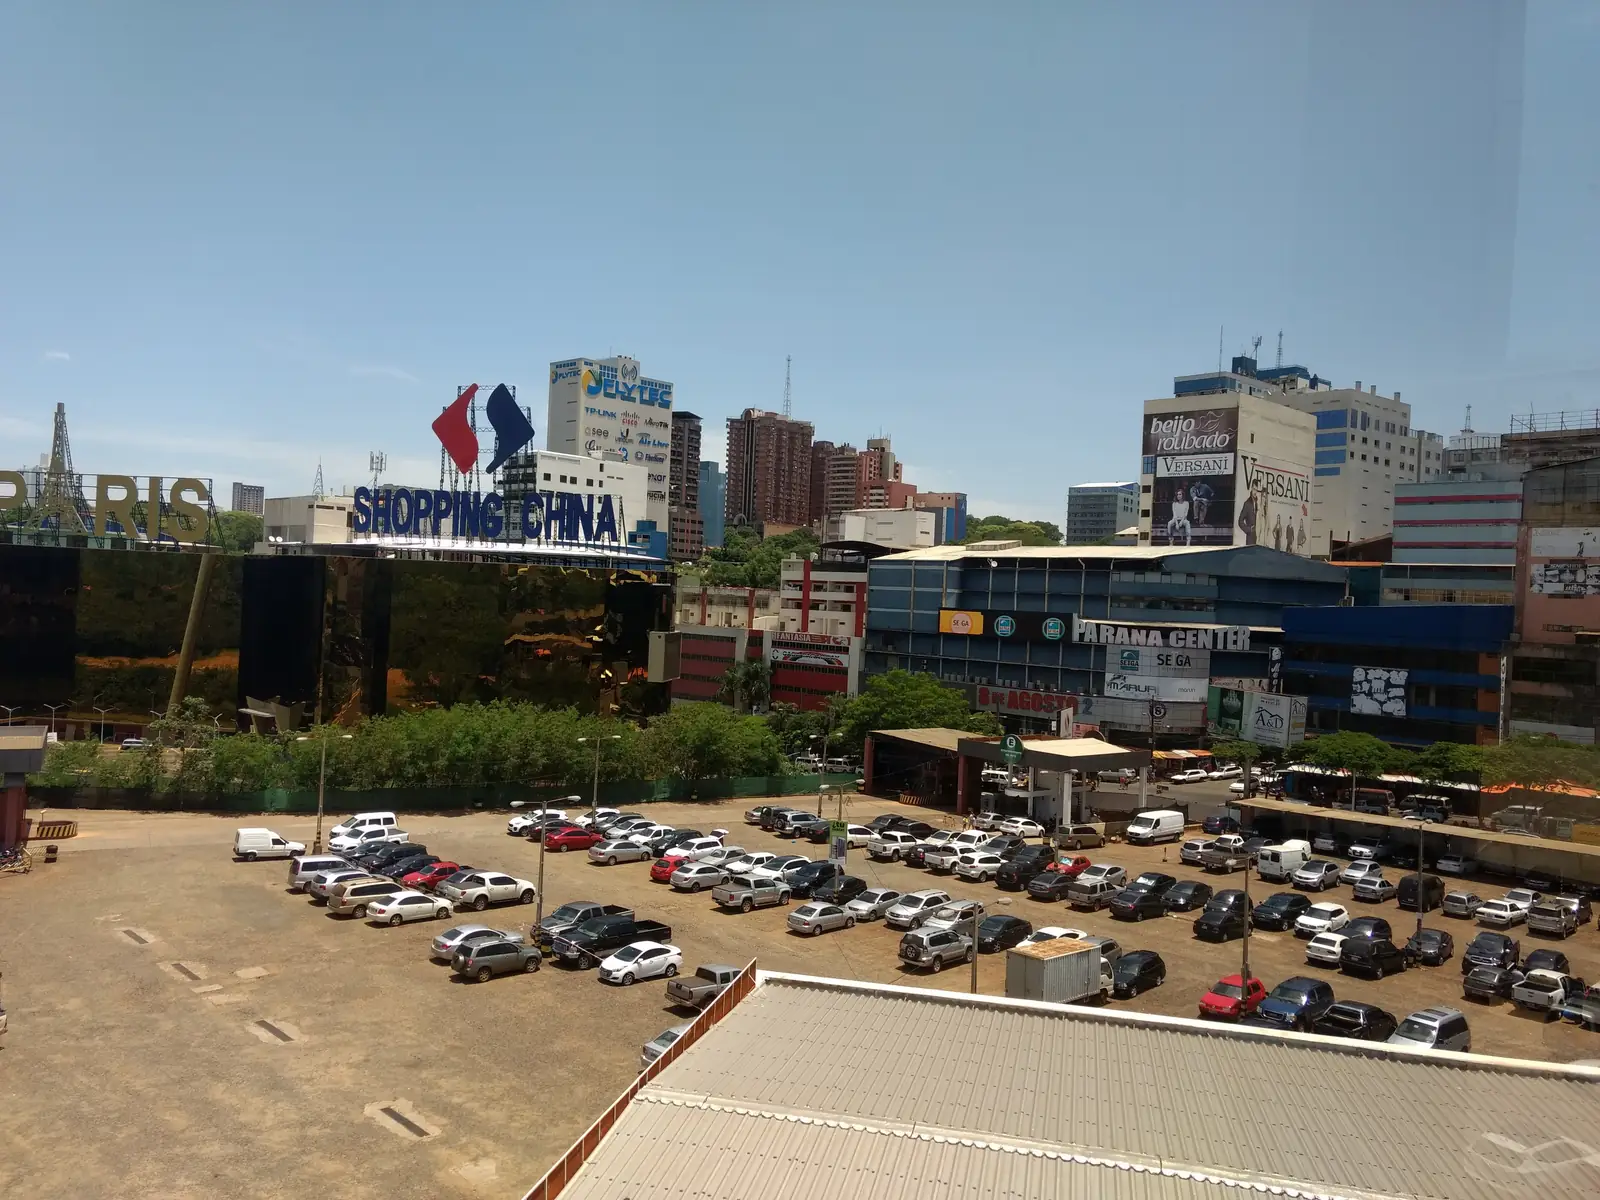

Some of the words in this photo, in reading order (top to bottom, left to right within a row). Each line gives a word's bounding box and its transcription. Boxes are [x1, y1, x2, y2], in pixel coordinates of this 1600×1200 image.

[585, 407, 617, 418] TP-LINK
[1150, 415, 1195, 437] beijo
[1157, 431, 1230, 451] roubado
[648, 473, 666, 481] exar
[647, 491, 666, 499] rucial
[353, 486, 502, 537] SHOPPING
[522, 492, 617, 541] CHINA
[777, 632, 811, 642] FANTASIA
[1072, 613, 1163, 647] PARANA
[1169, 625, 1250, 650] CENTER
[1007, 690, 1079, 716] AGOSTO
[1082, 698, 1093, 715] 2
[1255, 712, 1284, 729] A&D
